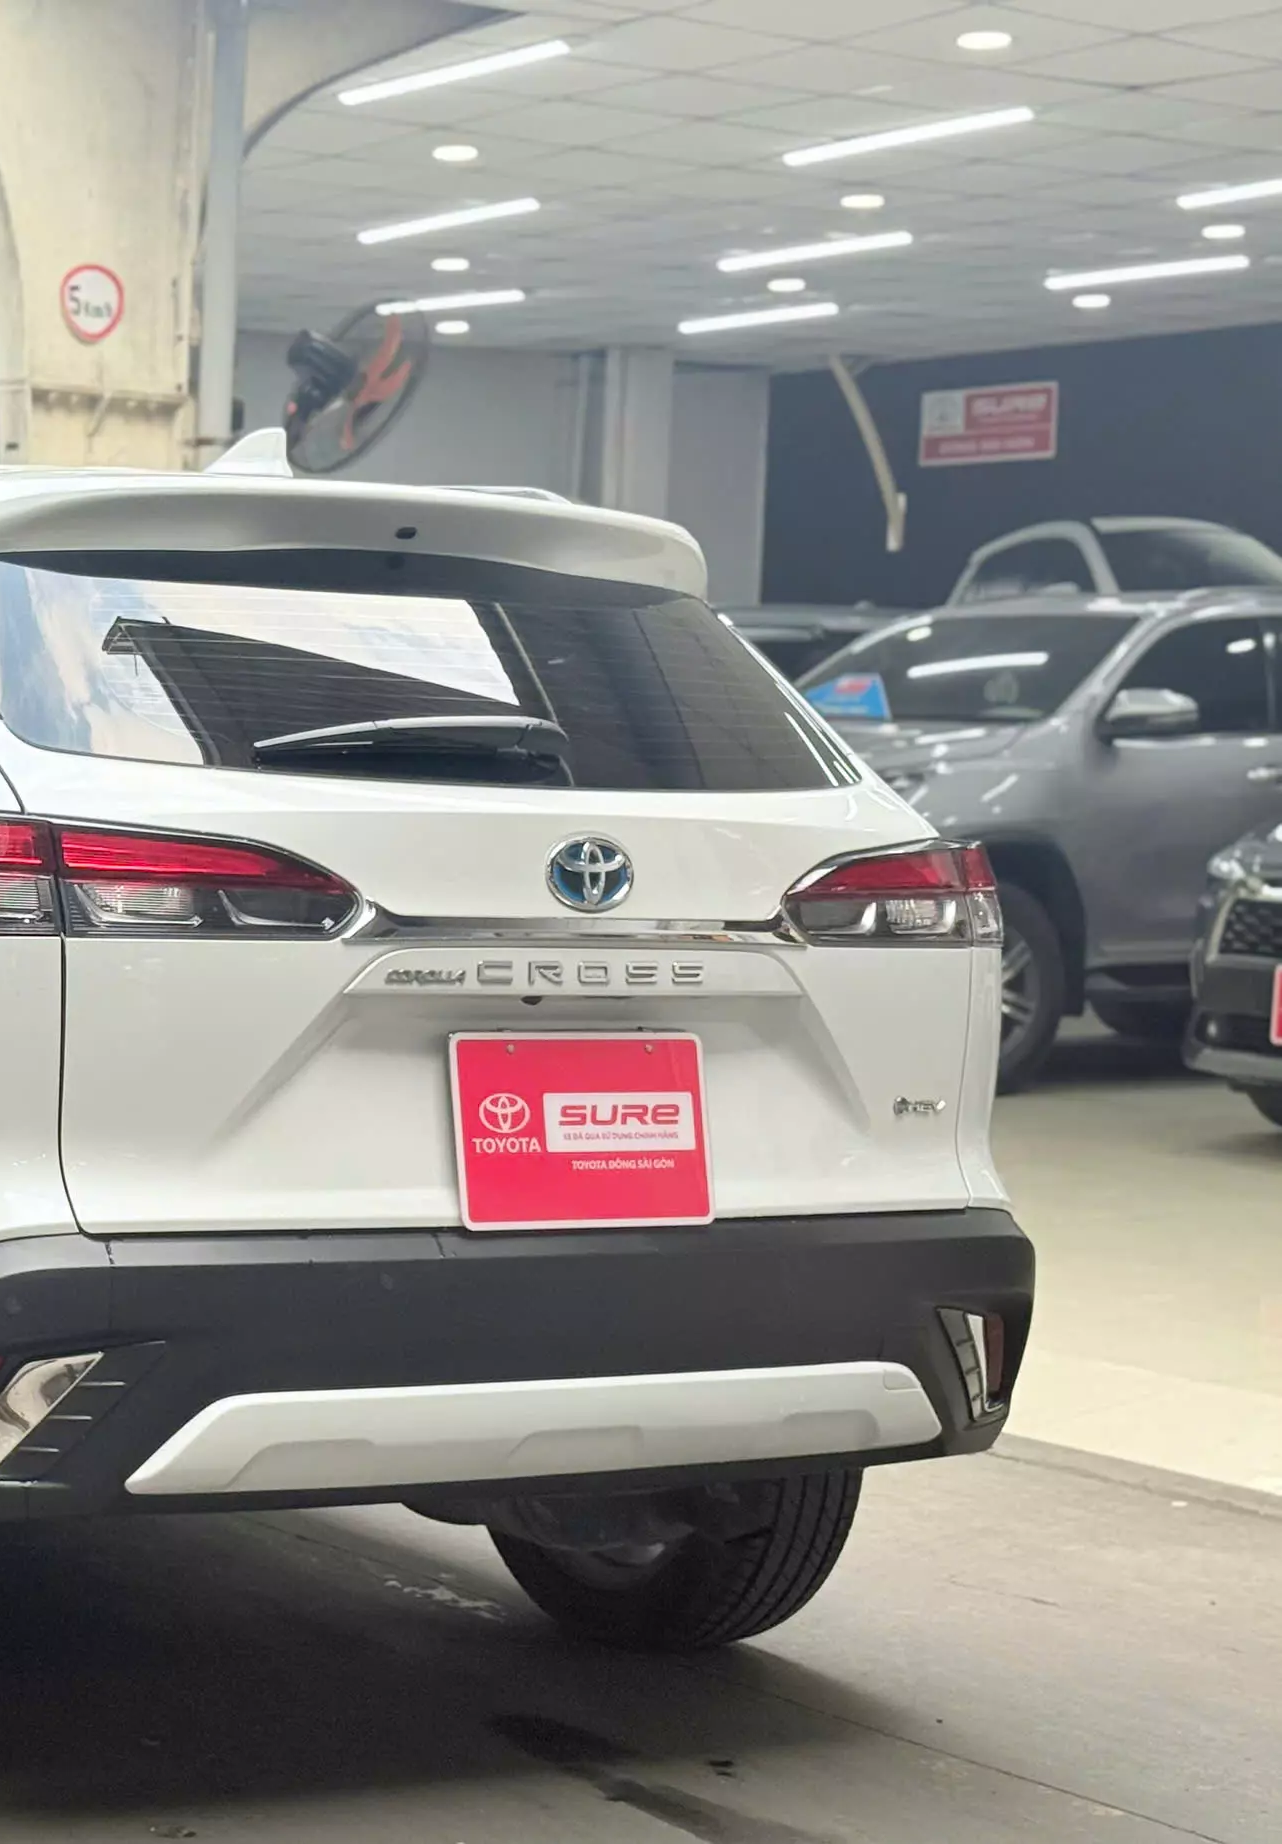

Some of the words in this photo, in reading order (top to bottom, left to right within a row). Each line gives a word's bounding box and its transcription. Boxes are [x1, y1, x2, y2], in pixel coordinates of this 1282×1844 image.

[68, 285, 81, 317] 5
[477, 960, 705, 985] CROSS
[558, 1104, 680, 1126] SURE
[471, 1136, 541, 1153] TOYOTA
[572, 1160, 606, 1171] TOYOTA
